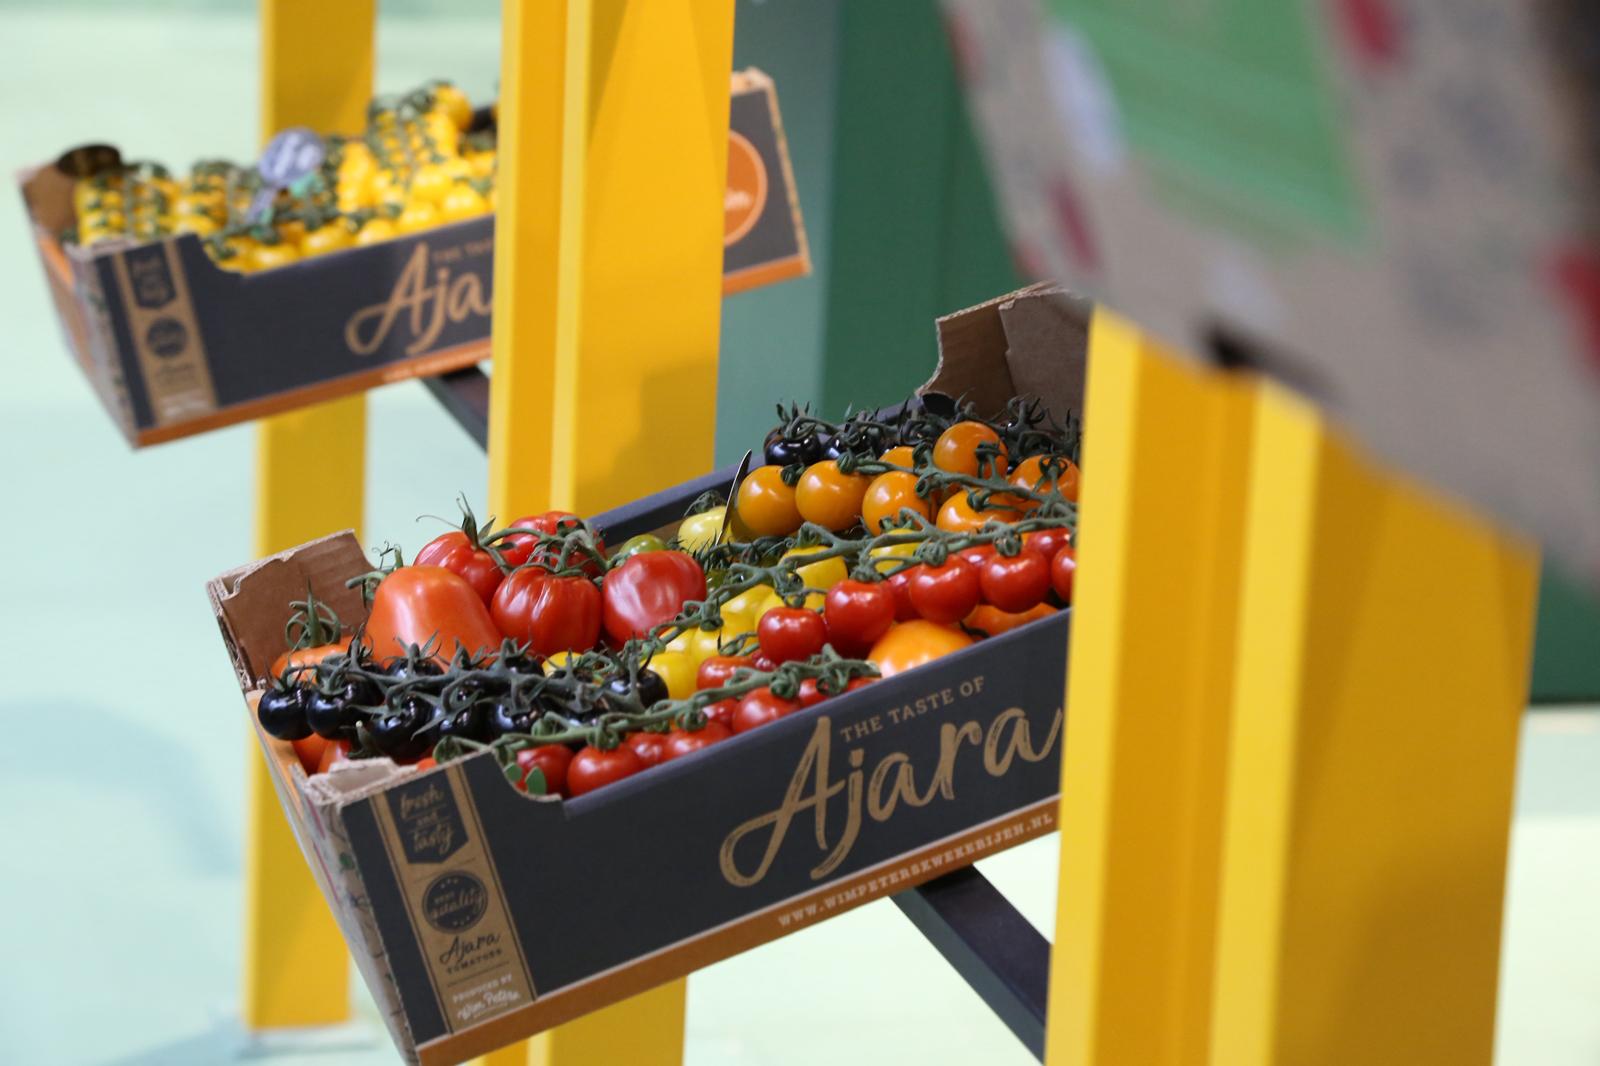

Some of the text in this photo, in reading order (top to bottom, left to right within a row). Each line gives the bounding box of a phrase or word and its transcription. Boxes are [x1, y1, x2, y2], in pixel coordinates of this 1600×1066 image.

[345, 241, 492, 356] Aja
[840, 675, 985, 743] THE TASTE OF
[719, 715, 1064, 887] Ajara
[440, 934, 502, 966] Ajara
